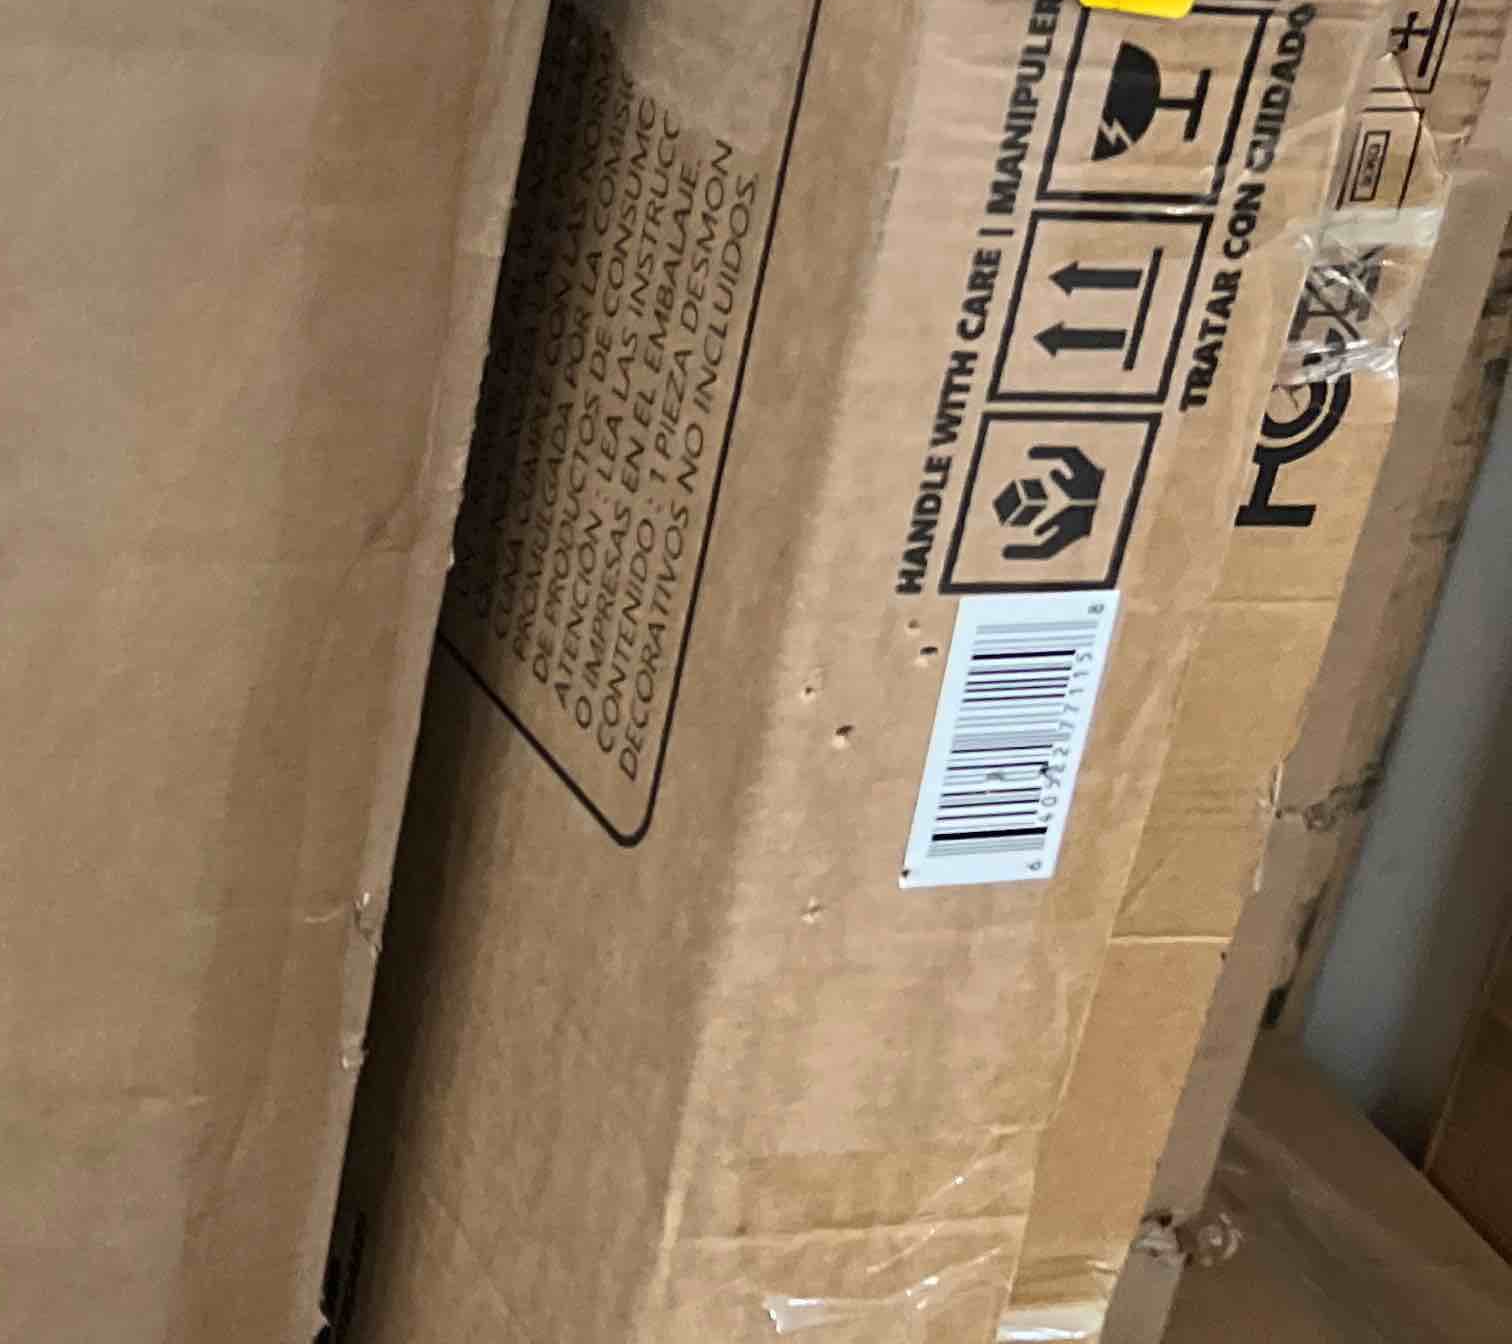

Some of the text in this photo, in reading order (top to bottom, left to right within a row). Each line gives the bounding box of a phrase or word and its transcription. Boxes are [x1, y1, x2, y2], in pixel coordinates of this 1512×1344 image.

[1180, 3, 1319, 413] TRATAR CON CUIDADO
[510, 389, 576, 666] PROMULGADA
[579, 237, 603, 299] LA
[587, 321, 612, 388] DE
[596, 402, 624, 486] LEA
[611, 320, 639, 404] LAS
[631, 372, 656, 435] EL
[895, 455, 952, 595] HANDLE
[931, 350, 978, 449] WITH
[958, 248, 1001, 342] CARE
[541, 383, 602, 630] PRODUCTOS
[594, 510, 656, 759] CONTENIDO
[654, 333, 692, 466] PIEZA
[617, 153, 759, 786] DECORATIVOS NO INCLUIDOS.
[619, 429, 645, 498] EN
[530, 626, 554, 688] DE
[581, 494, 633, 693] IMPRESAS
[573, 688, 594, 735] O
